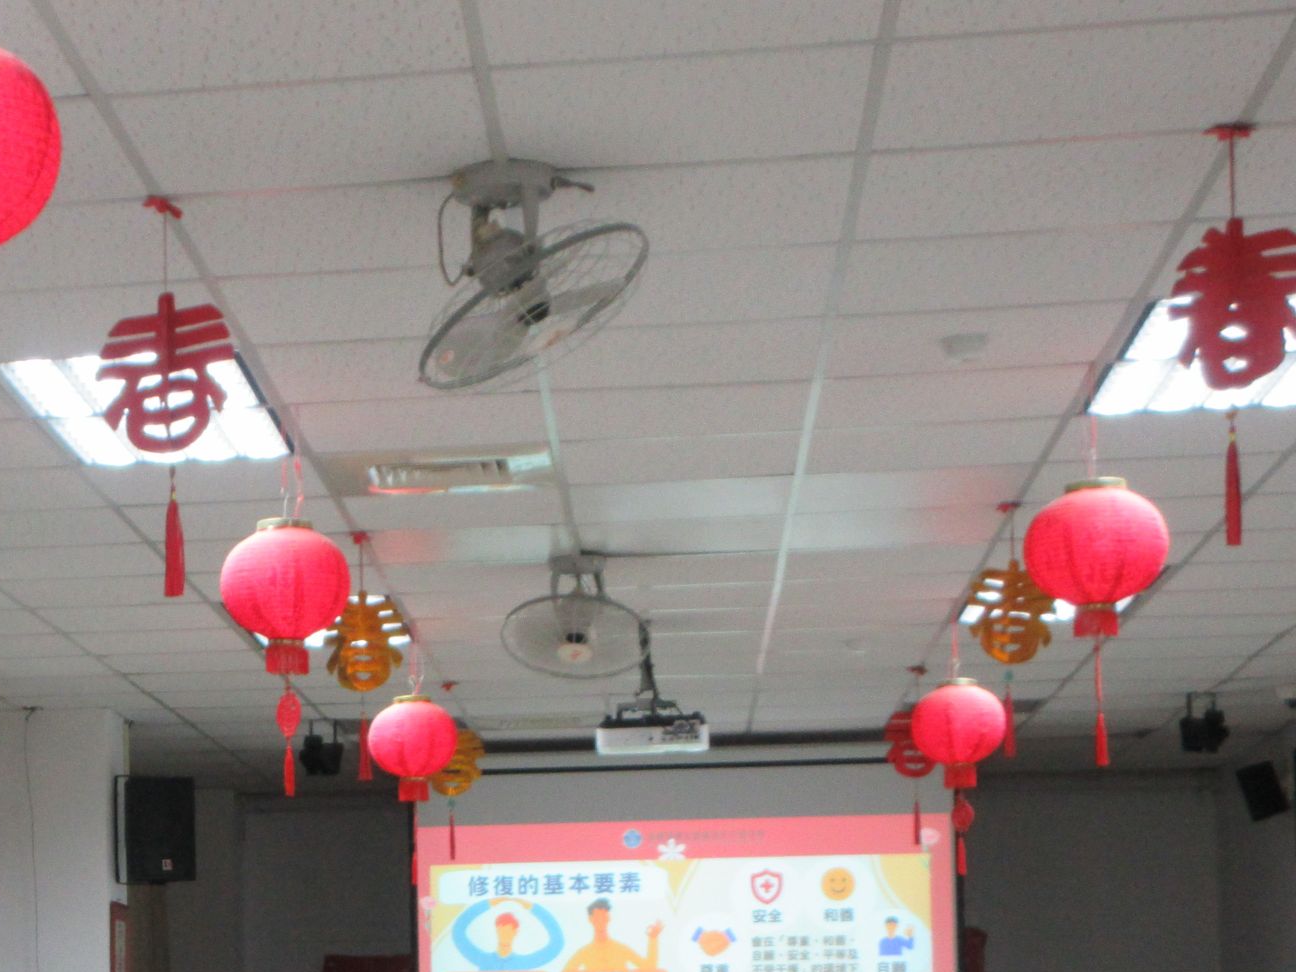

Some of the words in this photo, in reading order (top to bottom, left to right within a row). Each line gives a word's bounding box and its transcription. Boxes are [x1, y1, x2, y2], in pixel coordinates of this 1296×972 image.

[96, 291, 236, 453] 春
[468, 871, 641, 897] 修復的基本要素
[752, 909, 783, 924] 安全
[823, 908, 854, 923] 和善
